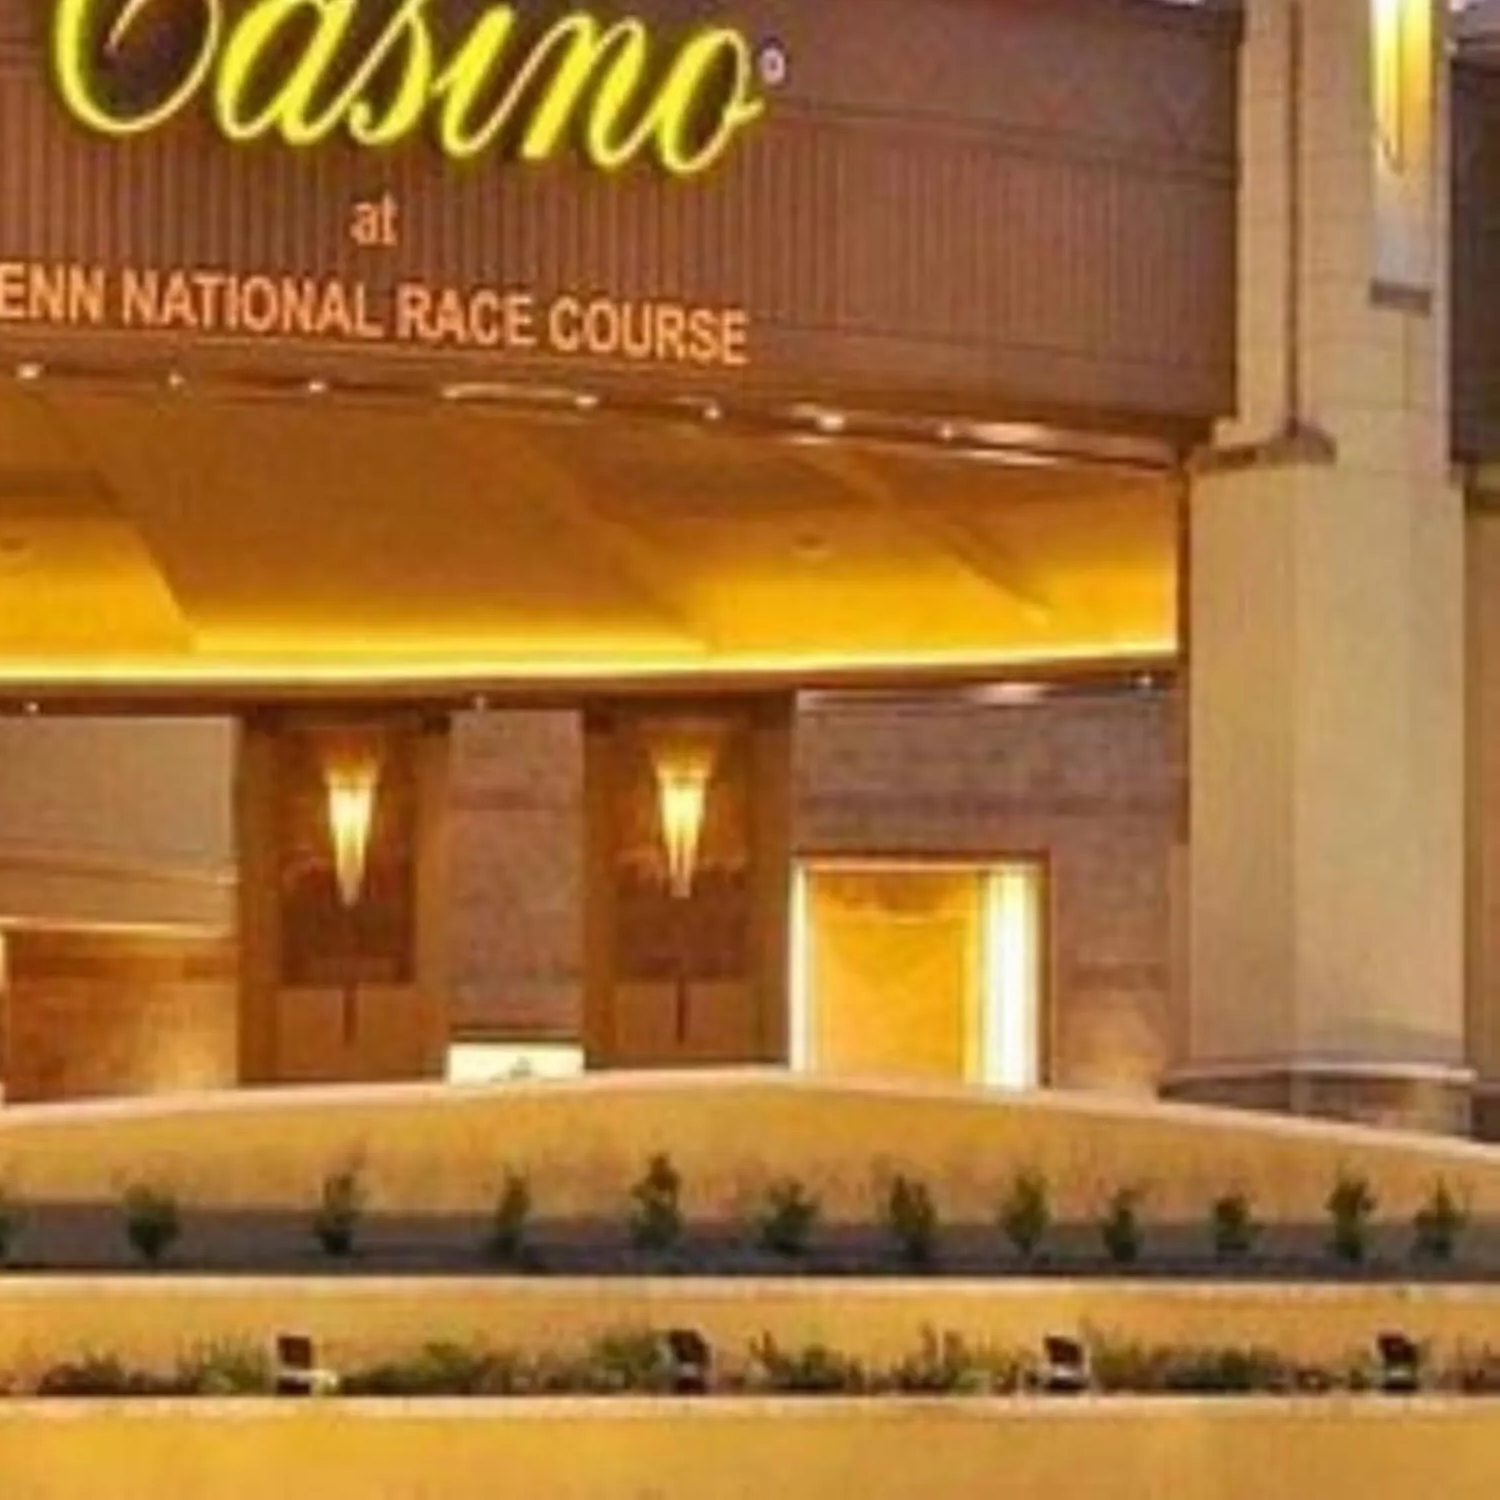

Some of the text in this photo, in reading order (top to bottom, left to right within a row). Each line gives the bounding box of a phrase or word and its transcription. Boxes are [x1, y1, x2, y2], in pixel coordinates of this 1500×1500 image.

[349, 192, 399, 247] at
[121, 270, 385, 339] NATIONAL
[397, 284, 534, 348] RACE
[548, 296, 750, 366] COURSE
